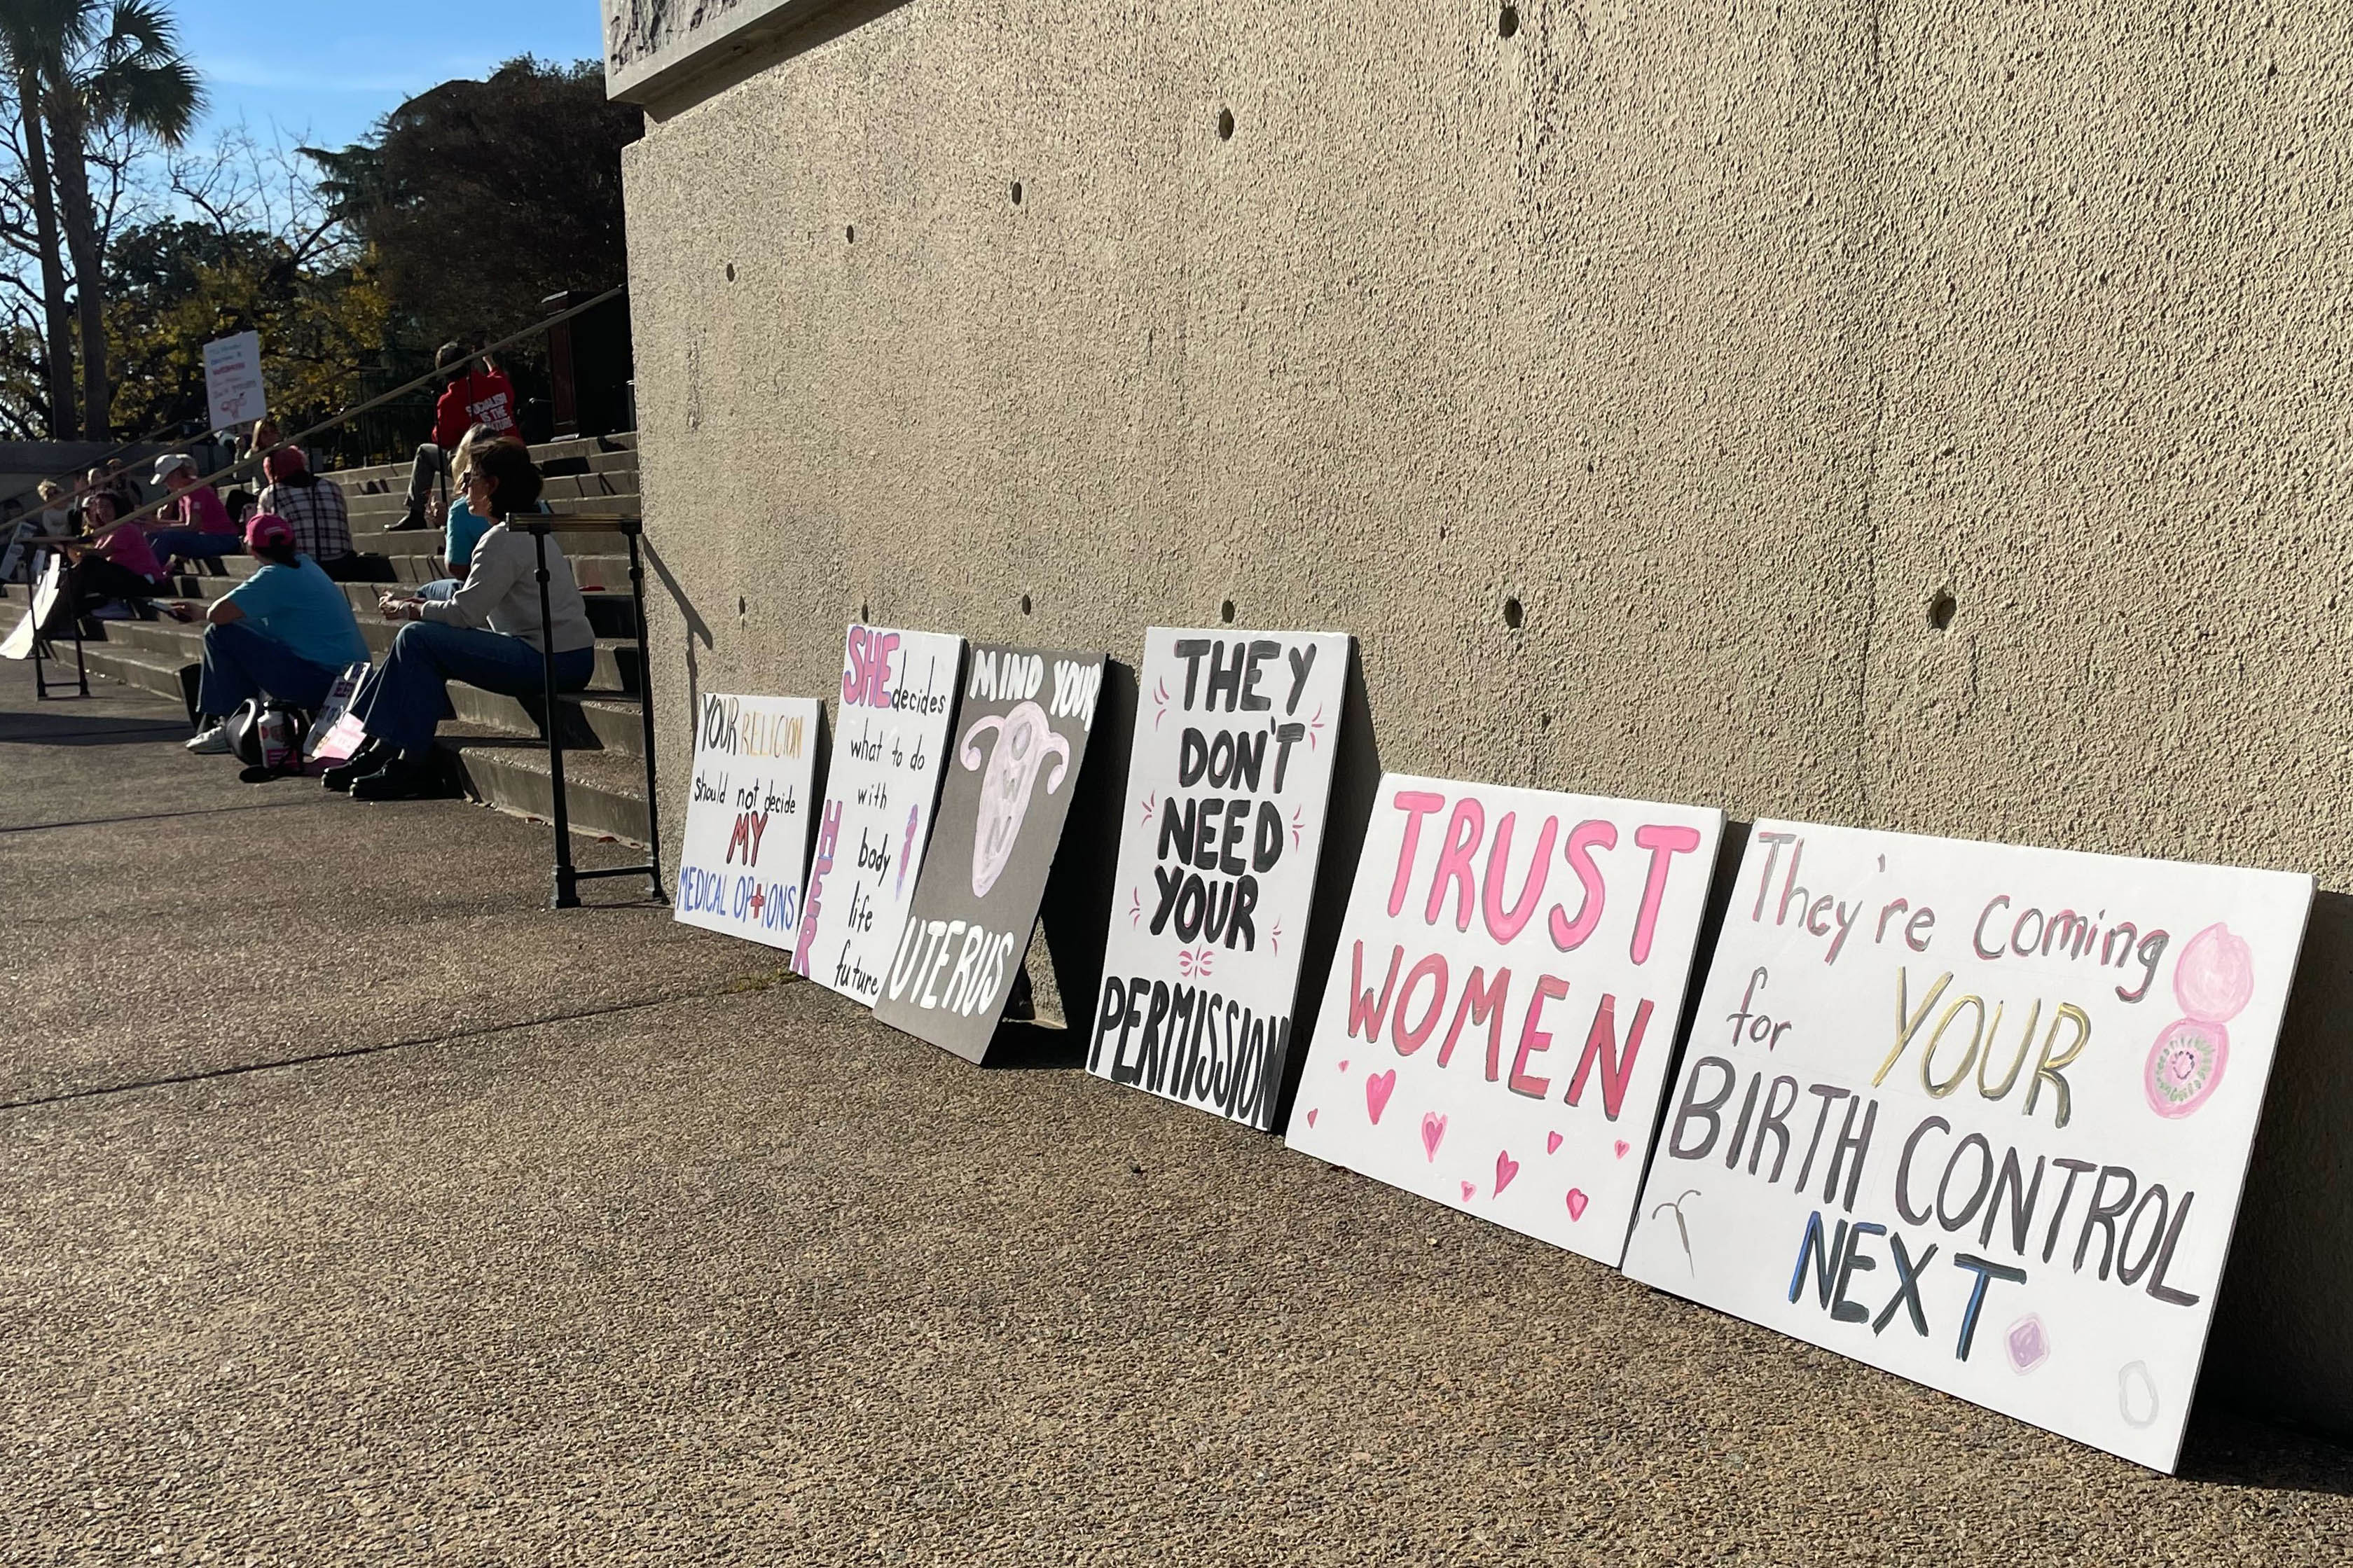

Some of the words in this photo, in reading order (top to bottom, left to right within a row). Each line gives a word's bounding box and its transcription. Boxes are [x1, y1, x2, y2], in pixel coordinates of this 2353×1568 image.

[490, 405, 508, 420] THE
[843, 627, 900, 709] SHE
[892, 650, 946, 715] decides
[970, 650, 1044, 701] MIND
[1051, 660, 1102, 732] YOUR
[1175, 639, 1318, 715] THEY
[703, 695, 739, 757] YOUR
[740, 711, 804, 760] RELIGION
[850, 718, 883, 763] what
[892, 729, 904, 768] to
[911, 735, 925, 771] do
[1179, 716, 1306, 793] DON'T
[694, 771, 726, 805] should
[737, 777, 759, 811] not
[764, 780, 796, 815] decide
[858, 783, 888, 810] with
[727, 812, 768, 867] MY
[858, 827, 890, 885] body
[1157, 796, 1283, 873] NEED
[680, 866, 726, 916] MEDICAL
[793, 800, 842, 978] HER
[849, 882, 873, 934] life
[1150, 864, 1258, 951] YOUR
[1388, 791, 1700, 965] TRUST
[1753, 831, 1935, 966] They're
[834, 939, 879, 997] future
[888, 916, 1014, 1017] UTERUS
[1089, 976, 1291, 1130] PERMISSION
[1348, 939, 1654, 1123] WOMEN
[1727, 966, 1792, 1052] for
[1872, 966, 2091, 1128] YOUR
[1669, 1056, 1879, 1214] BIRTH
[1895, 1116, 2200, 1307] CONTROL
[1788, 1211, 2027, 1361] NEXT
